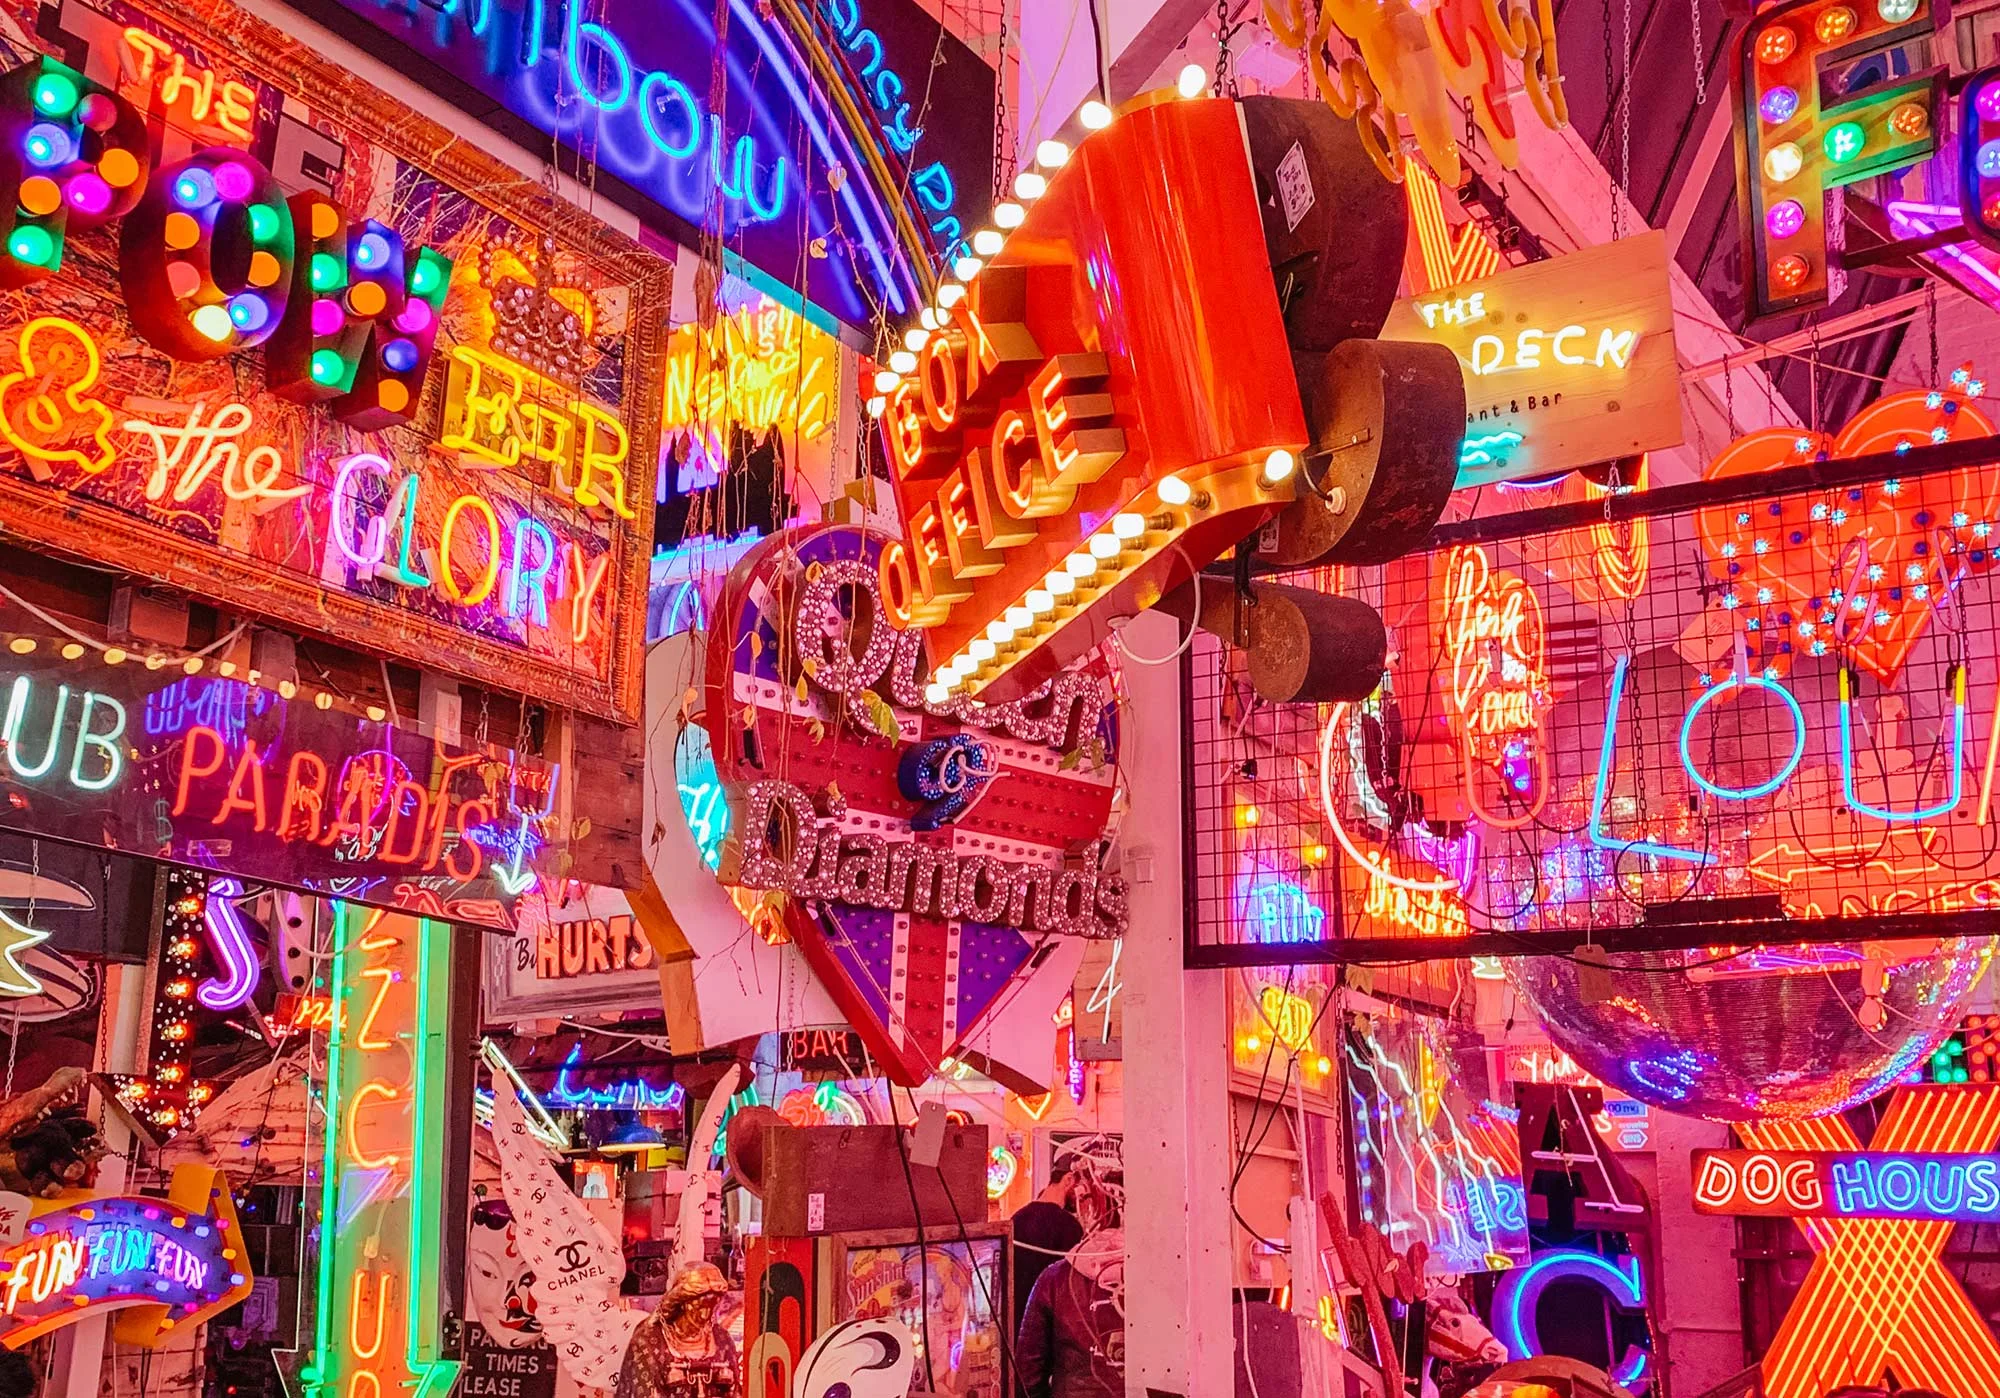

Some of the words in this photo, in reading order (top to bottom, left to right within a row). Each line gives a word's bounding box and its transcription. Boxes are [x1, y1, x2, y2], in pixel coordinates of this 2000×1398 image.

[123, 27, 258, 142] THE
[1422, 292, 1486, 328] THE
[885, 268, 1020, 481] BOX
[1472, 325, 1633, 376] DECK
[1467, 405, 1501, 423] ant
[1510, 399, 1519, 414] &
[1527, 392, 1562, 410] Bar
[123, 401, 313, 502] the
[332, 453, 610, 643] GLORY
[879, 352, 1110, 631] OFFICE
[4, 675, 126, 790] UB
[172, 726, 488, 882] PARADIS
[1588, 653, 2000, 866] LOU
[741, 779, 1130, 939] Diamonds
[536, 914, 655, 980] HURTS
[793, 1029, 849, 1059] BAR
[1695, 1155, 1823, 1211] DOG
[1831, 1158, 2000, 1215] HOUS
[6, 1236, 85, 1315] FUN
[89, 1228, 153, 1281] FUN
[156, 1239, 208, 1290] FUN
[547, 1264, 606, 1291] CHANEL
[846, 1261, 912, 1313] Sunshine
[463, 1375, 521, 1397] LEASE
[485, 1353, 540, 1375] TIMES
